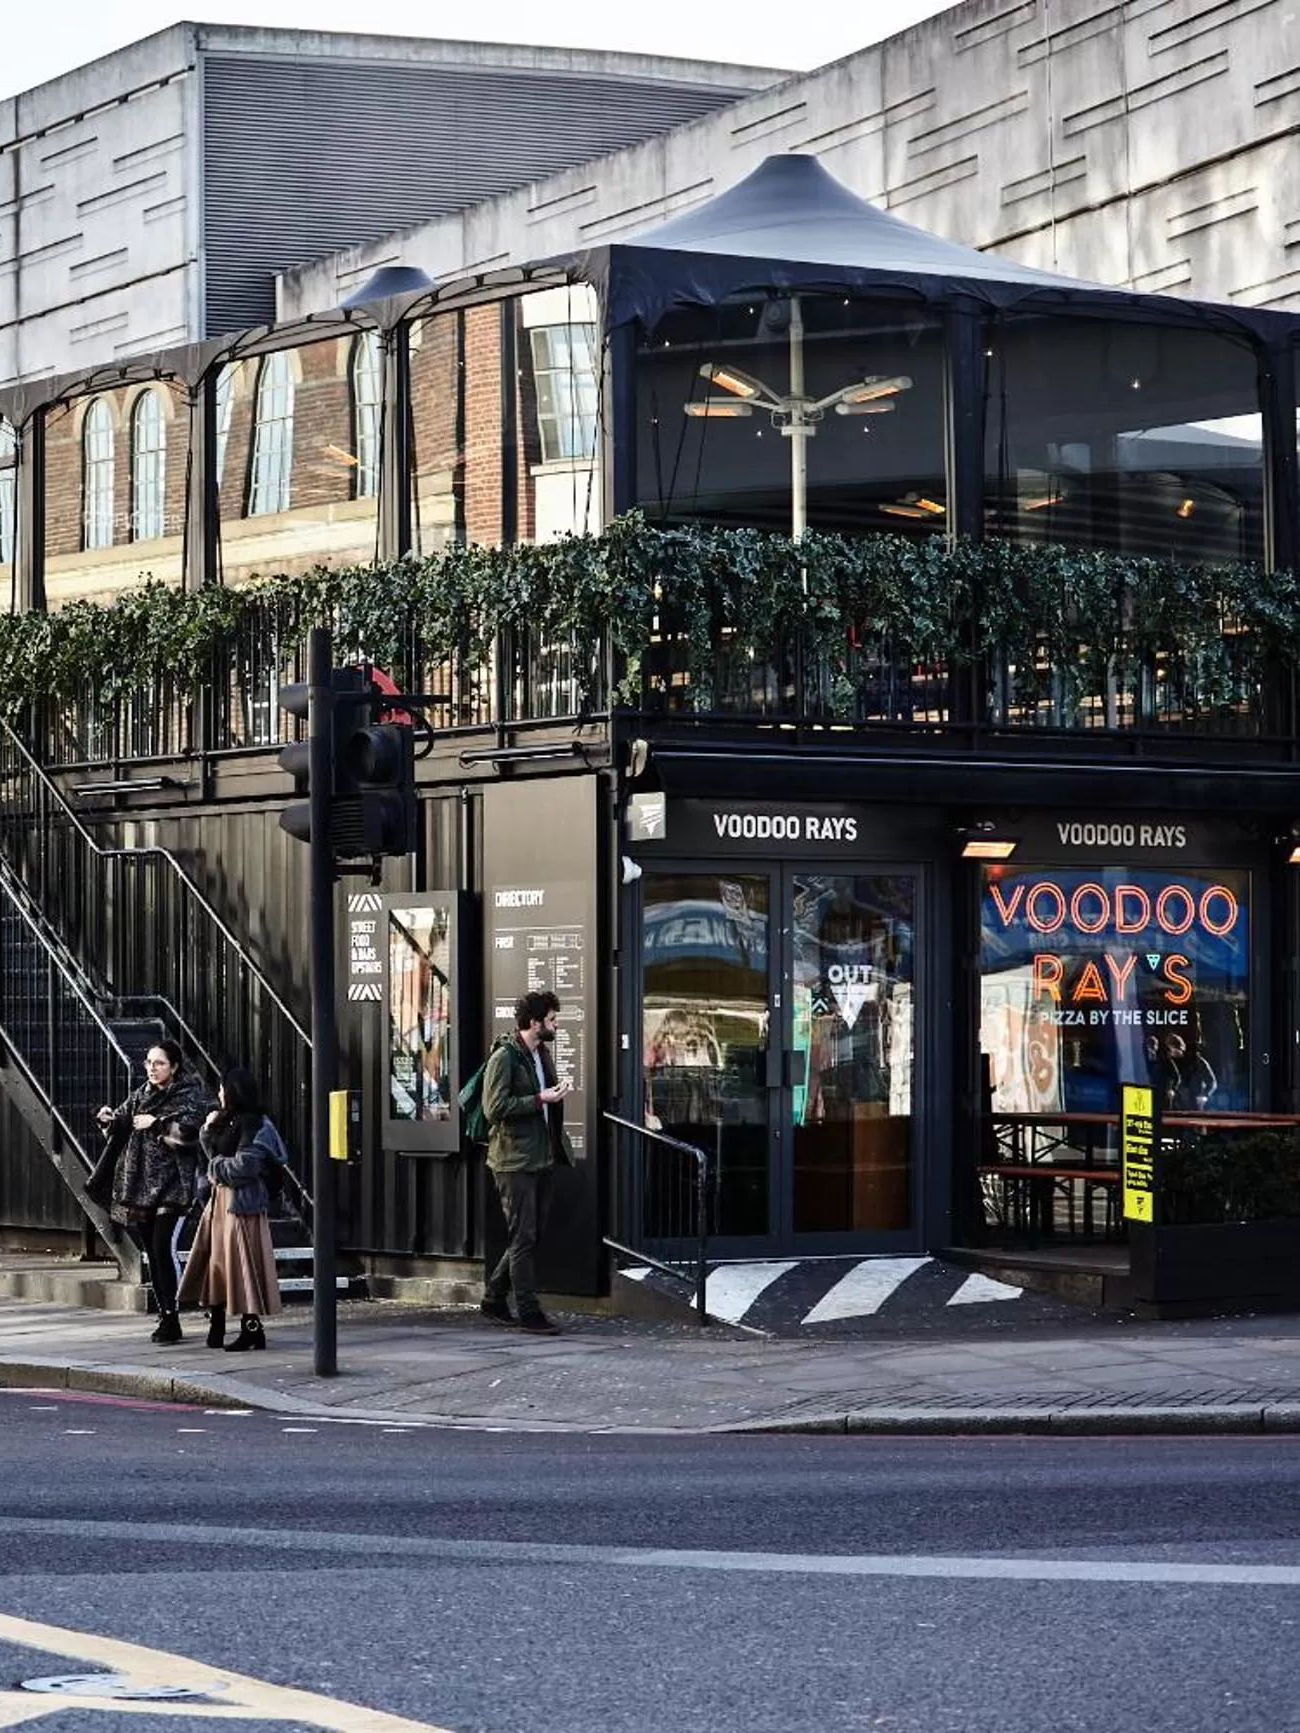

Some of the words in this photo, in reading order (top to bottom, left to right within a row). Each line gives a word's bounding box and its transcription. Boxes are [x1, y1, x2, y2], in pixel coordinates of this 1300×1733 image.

[713, 814, 800, 839] VOODOO
[805, 817, 858, 841] RAYS
[1057, 823, 1135, 846] VOODOO
[1140, 825, 1187, 848] RAYS
[495, 890, 544, 907] DIRECTORY
[989, 881, 1238, 935] VOODOO
[827, 964, 873, 984] OUT
[1033, 952, 1195, 1004] RAY'S
[1040, 1010, 1086, 1025] PIZZA
[1089, 1010, 1109, 1025] BY
[1112, 1010, 1141, 1025] THE
[1146, 1010, 1188, 1025] SLICE
